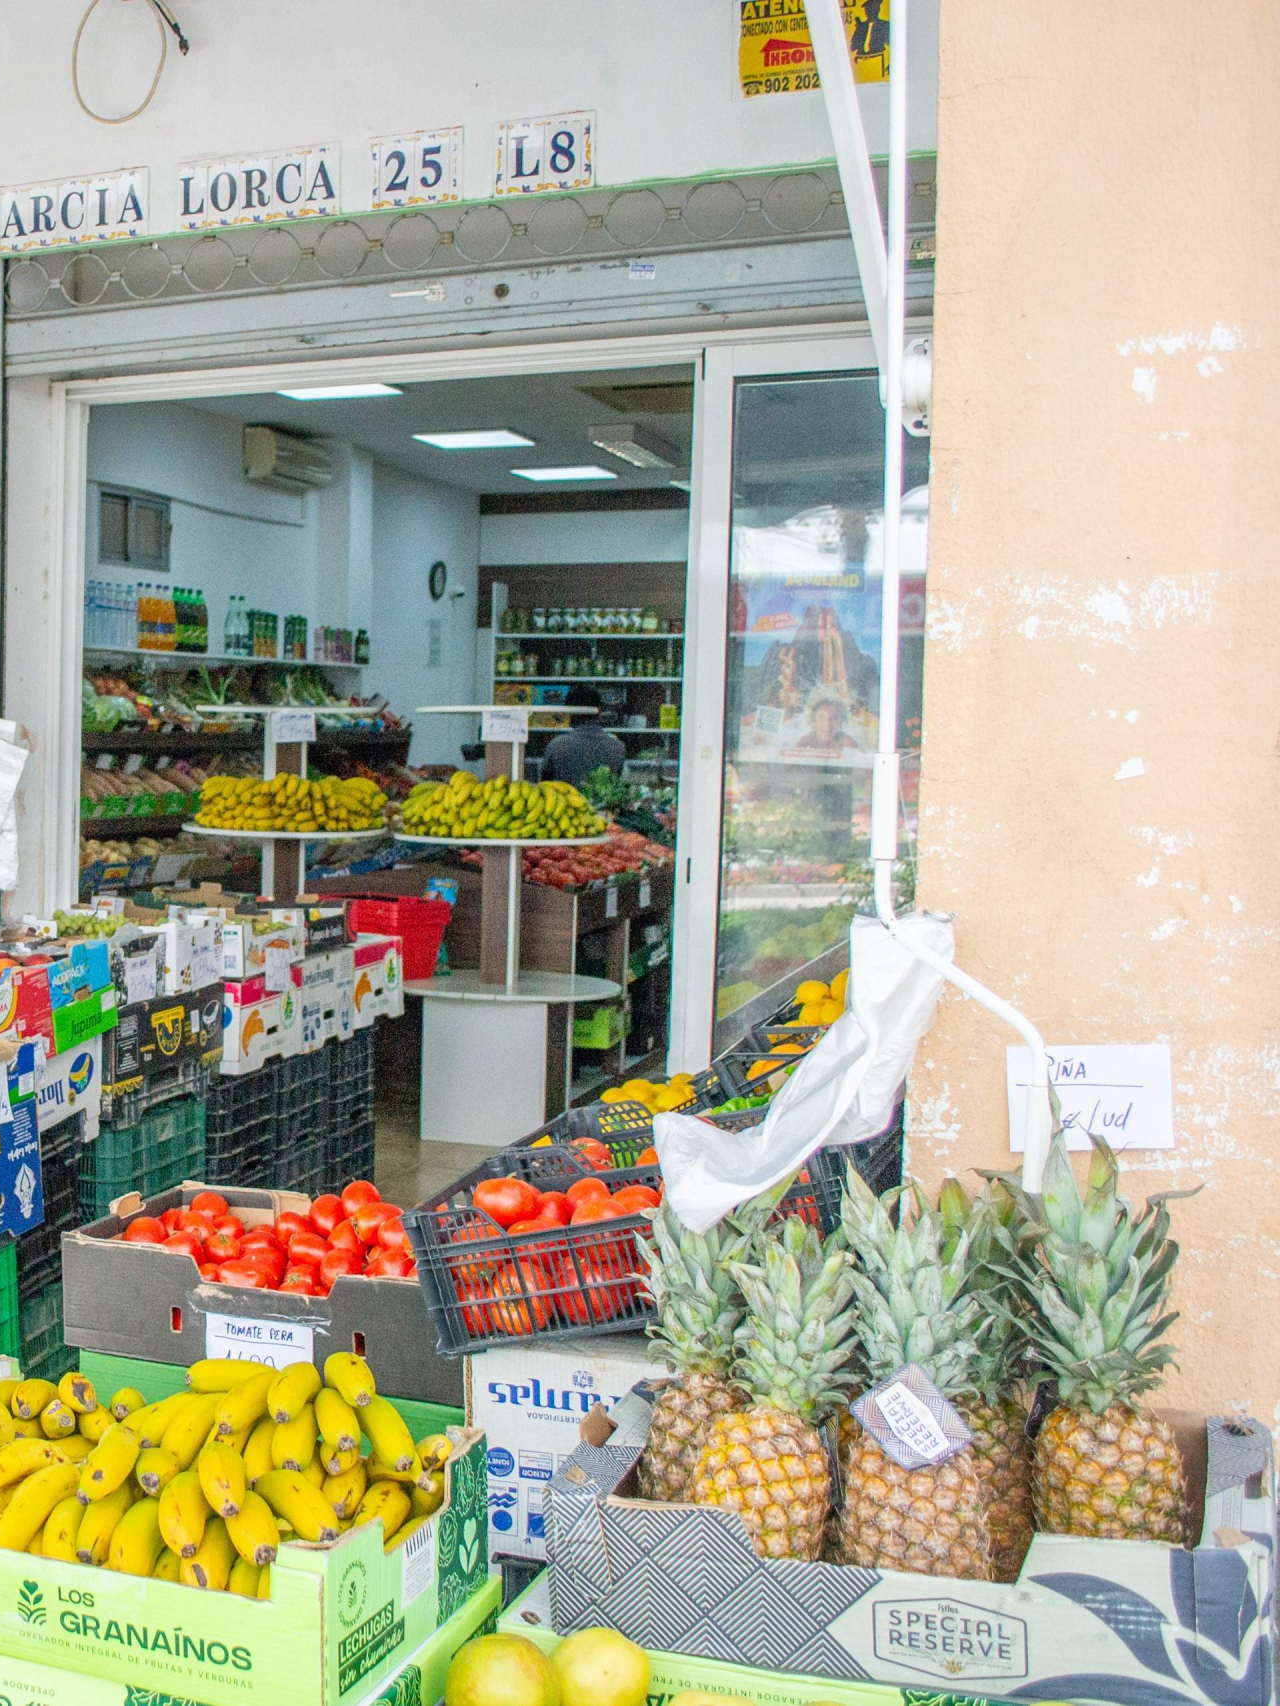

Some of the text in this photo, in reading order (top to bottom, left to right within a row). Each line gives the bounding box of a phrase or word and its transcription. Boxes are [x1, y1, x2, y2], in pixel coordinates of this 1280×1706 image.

[742, 0, 806, 19] ATEN
[765, 77, 789, 93] 902
[180, 159, 336, 217] LORCA
[384, 144, 443, 193] 25
[511, 129, 576, 181] L8
[224, 1322, 294, 1342] TOMATE PERA
[884, 1398, 931, 1453] SPECIAL
[891, 1391, 940, 1448] RESERVE
[57, 1586, 95, 1608] LOS
[339, 1603, 393, 1665] LECHUGAS
[888, 1609, 1011, 1640] SPECIAL
[59, 1610, 253, 1671] GRANAÍNOS
[888, 1629, 1012, 1660] RESERVE
[19, 1630, 71, 1648] OPERADOR
[74, 1643, 123, 1661] INTEGRAL
[127, 1655, 140, 1665] DE
[145, 1658, 183, 1674] FRUTAS
[197, 1669, 254, 1690] VERDURAS
[3, 1678, 56, 1697] OPERADOR
[678, 1679, 692, 1688] DE
[697, 1682, 752, 1698] INTEGRAL
